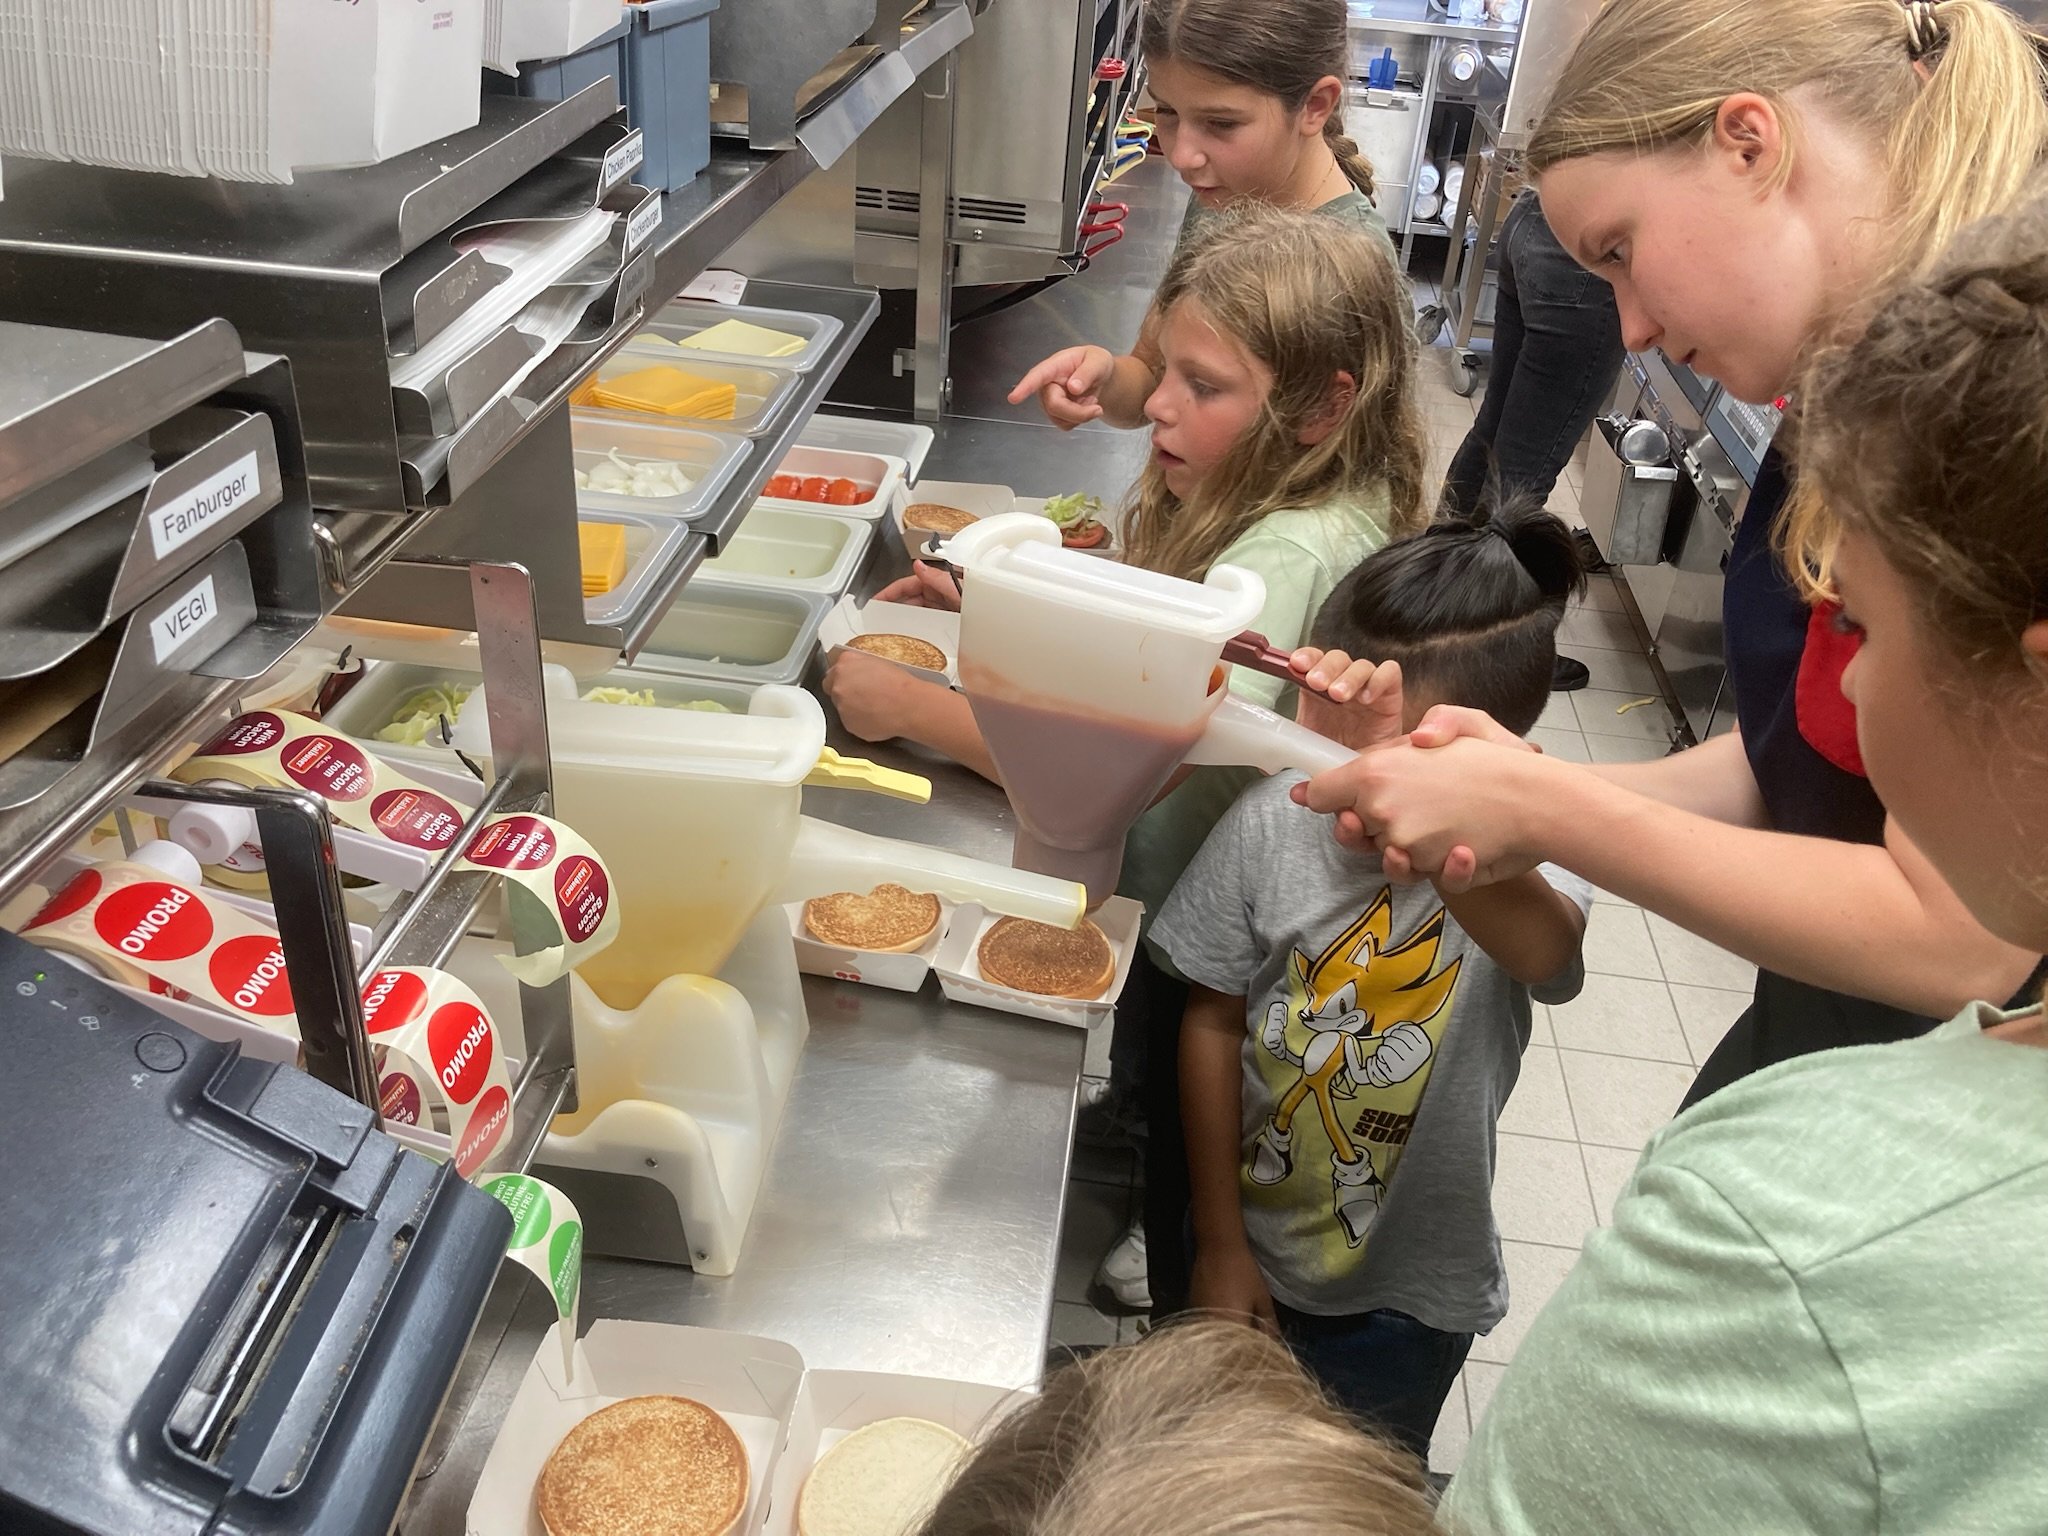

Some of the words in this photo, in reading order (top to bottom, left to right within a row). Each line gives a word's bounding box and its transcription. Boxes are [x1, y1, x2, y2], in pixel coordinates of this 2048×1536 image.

[607, 155, 626, 179] Chicken
[626, 143, 643, 164] Paprika
[630, 207, 659, 243] Chickenburger
[162, 474, 248, 541] Fanburger
[165, 592, 208, 639] VEGI
[235, 721, 272, 747] Bacon
[253, 729, 277, 745] With
[296, 741, 326, 767] Malbuner
[323, 759, 346, 778] from
[329, 763, 363, 791] Bacon
[346, 776, 367, 794] With
[413, 811, 435, 829] from
[420, 812, 452, 841] Bacon
[436, 823, 458, 841] With
[479, 826, 505, 853] Malbuner
[506, 832, 527, 851] from
[517, 831, 545, 861] Bacon
[531, 843, 551, 861] With
[564, 866, 588, 898] Malbuner
[577, 895, 603, 931] Bacon
[578, 891, 596, 914] from
[119, 887, 191, 953] PROMO
[584, 914, 601, 933] With
[364, 973, 401, 1022] PROM
[442, 1014, 489, 1089] PROMO
[455, 1099, 508, 1169] PROMO
[523, 1193, 535, 1210] FREI
